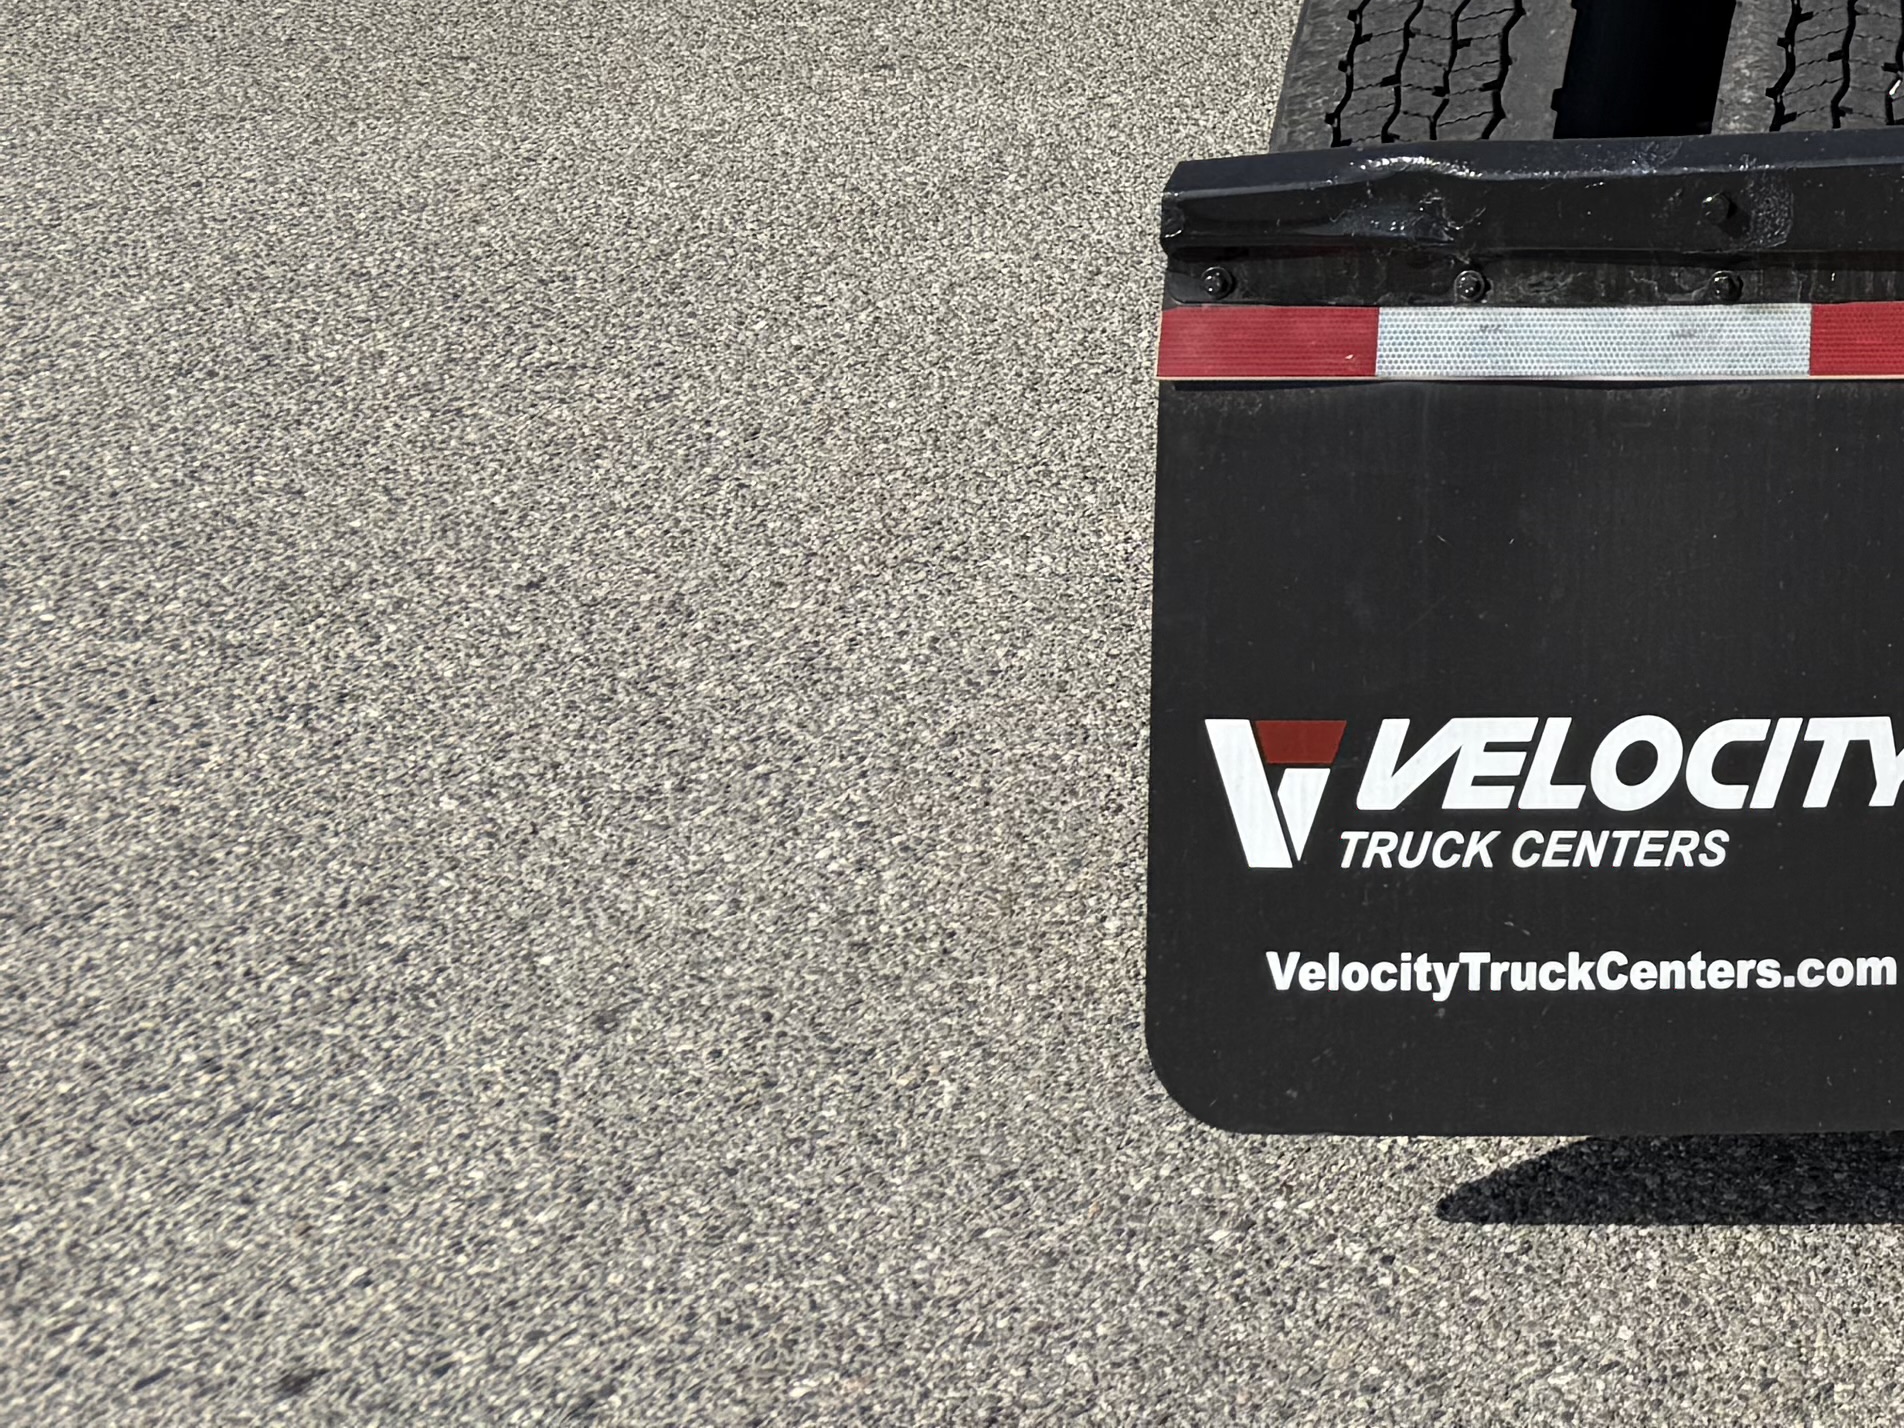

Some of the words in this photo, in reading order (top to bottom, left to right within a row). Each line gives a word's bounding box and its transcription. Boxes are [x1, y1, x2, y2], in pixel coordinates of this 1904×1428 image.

[1339, 828, 1502, 870] TRUCK
[1511, 828, 1731, 870] CENTERS
[1264, 949, 1898, 1003] VelocityTruckCenters.com
